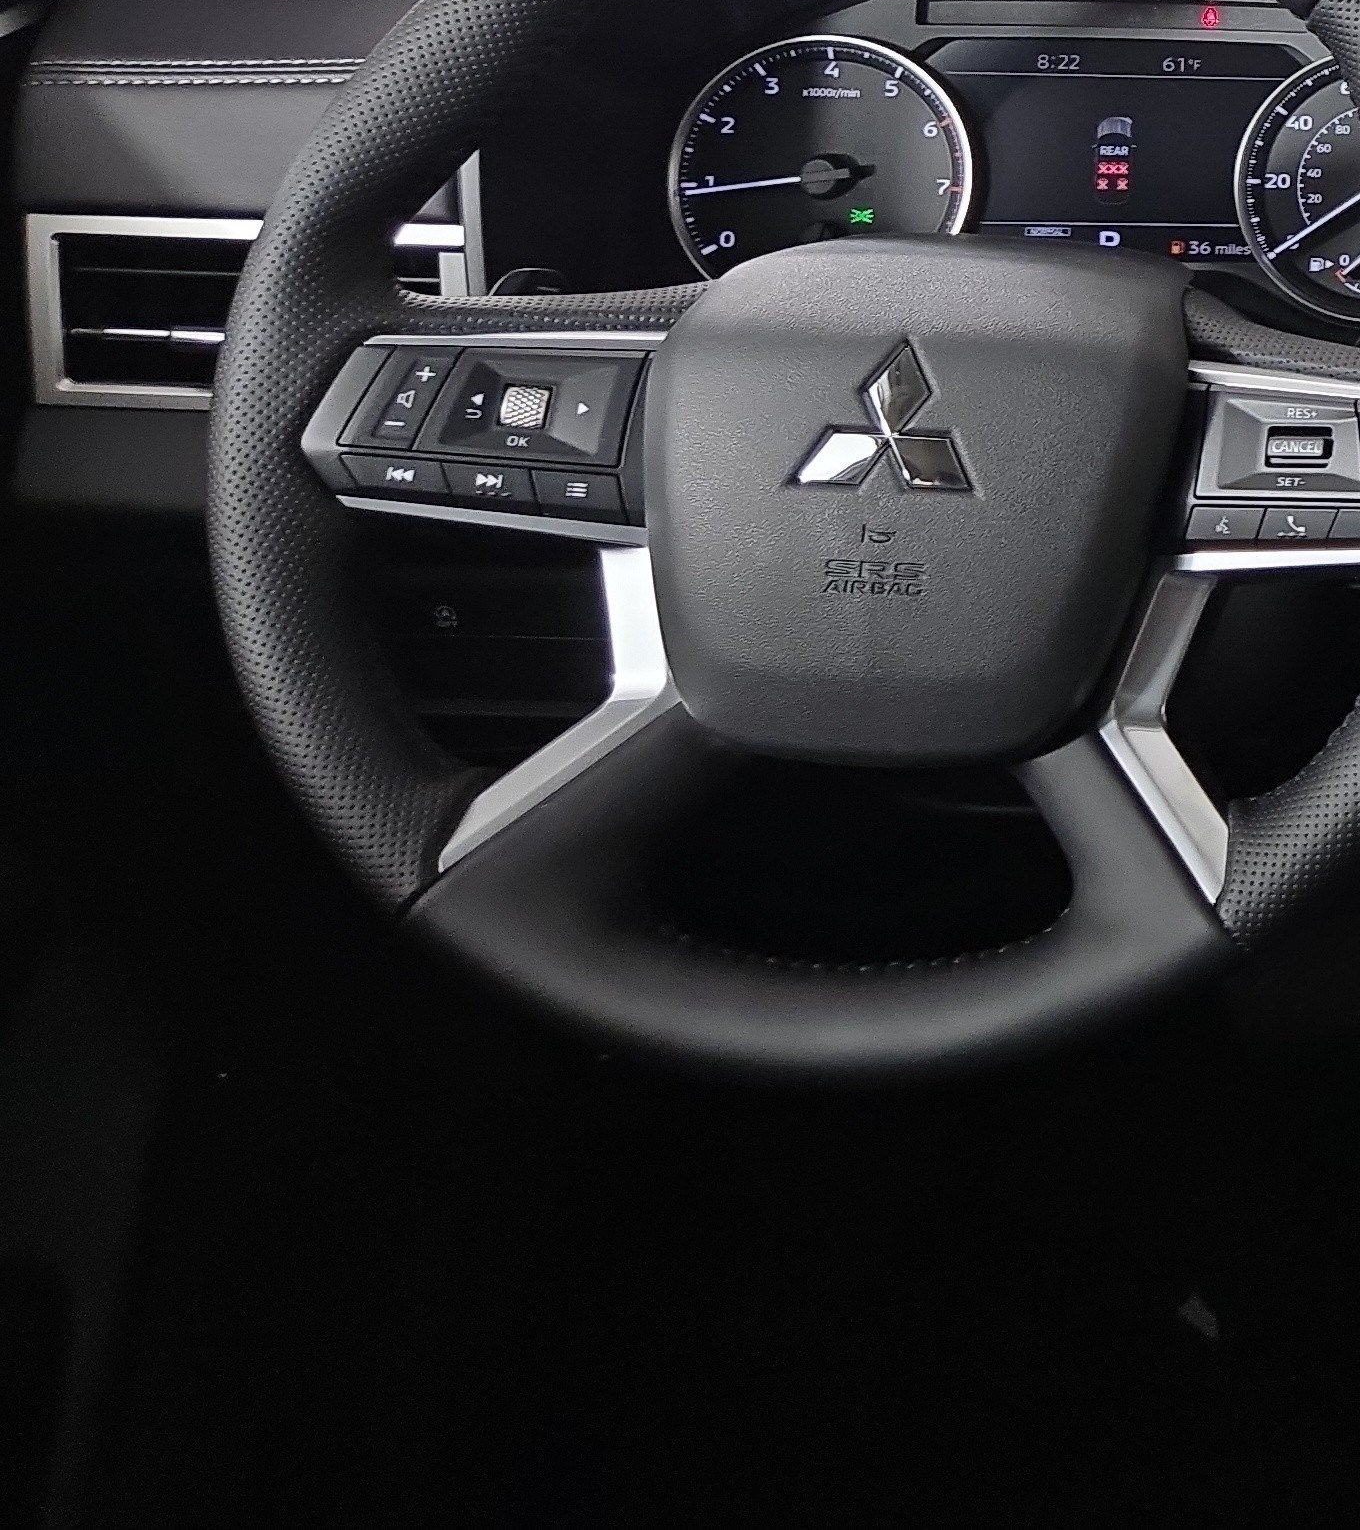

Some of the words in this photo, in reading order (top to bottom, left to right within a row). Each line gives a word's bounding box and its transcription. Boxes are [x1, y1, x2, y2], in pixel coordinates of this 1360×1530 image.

[824, 61, 840, 78] 4
[1036, 54, 1080, 70] 8:22
[764, 77, 780, 95] 3
[884, 80, 900, 97] 5
[720, 117, 735, 134] 2
[923, 122, 938, 138] 6
[1285, 115, 1313, 131] 40
[1335, 124, 1351, 135] 80
[1099, 145, 1129, 156] REAR
[1316, 143, 1332, 154] 60
[1307, 167, 1322, 178] 40
[936, 178, 951, 196] 7
[1264, 173, 1290, 189] 20
[1307, 193, 1323, 204] 20
[719, 230, 736, 248] 0
[1099, 231, 1120, 246] D
[1188, 241, 1211, 255] 36
[1214, 244, 1250, 255] miles
[1339, 254, 1351, 267] 0
[1286, 407, 1318, 419] RES+
[506, 435, 531, 448] OK
[1271, 440, 1324, 454] CANCEL
[825, 558, 926, 580] SRS
[821, 579, 923, 596] AIRBAG
